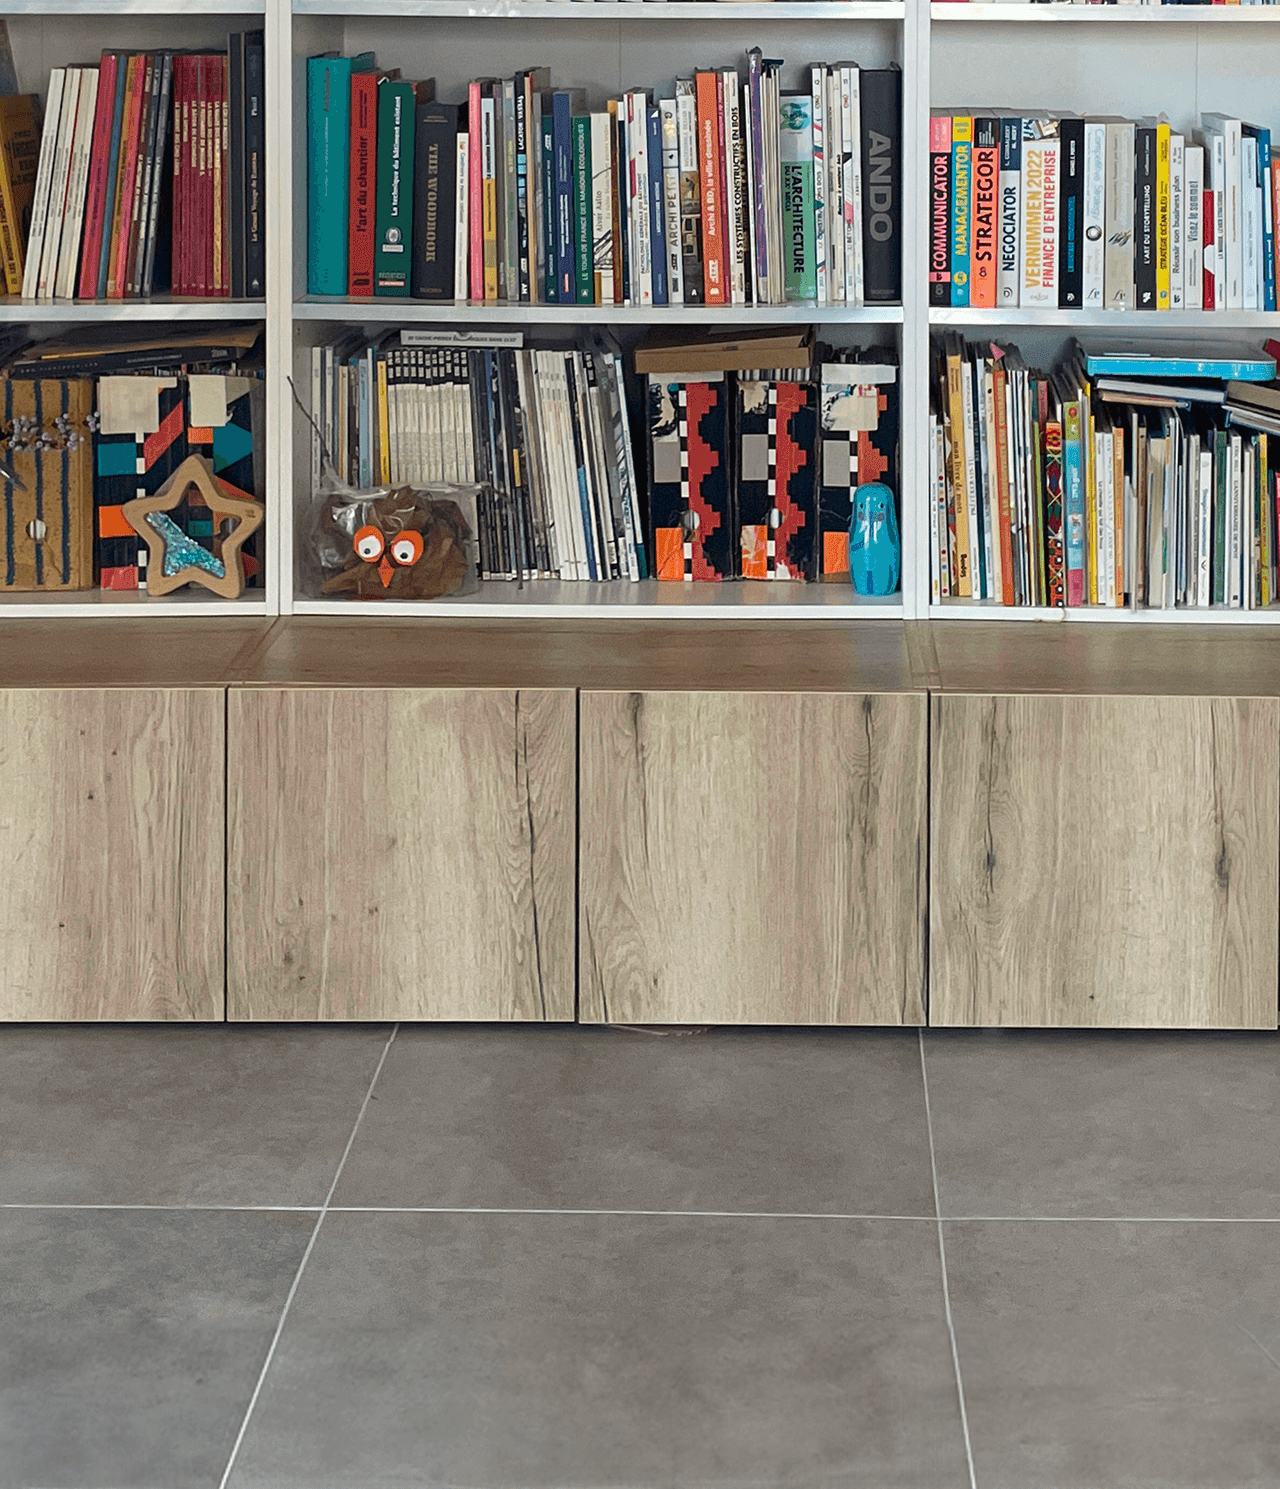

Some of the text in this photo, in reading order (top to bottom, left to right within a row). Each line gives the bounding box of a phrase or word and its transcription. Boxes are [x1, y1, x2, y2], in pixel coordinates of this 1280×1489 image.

[356, 136, 368, 232] l'art du chantier
[391, 96, 401, 216] La technique du bâtiment existant
[730, 107, 743, 264] LES SYSTÈMES CONSTRUCTIFS EN BOIS
[869, 130, 892, 241] ANDO
[1172, 175, 1182, 192] plan
[426, 144, 438, 262] THE WOODBOOK
[595, 190, 603, 210] Aalto
[704, 160, 717, 236] Archi BD, la ville
[791, 165, 805, 274] L'ARCHITECTURE
[933, 156, 948, 270] COMMUNICATOR
[955, 145, 968, 256] MANAGEMENTOR
[975, 150, 994, 262] STRATEGOR
[1002, 186, 1017, 272] NEGOCIATOR
[1025, 150, 1043, 288] VERNIMMEN 2022
[1042, 150, 1056, 288] FINANCE D'ENTREPRISE
[1143, 184, 1152, 265] L'ART DU STORYTELLING
[1158, 196, 1168, 236] OCÉAN BLEU
[1172, 194, 1181, 228] business
[1187, 181, 1199, 242] Visez le sommet
[1172, 246, 1181, 274] Réussir
[954, 460, 962, 477] livre
[954, 479, 960, 492] de
[955, 495, 963, 514] mots
[960, 553, 969, 578] Bordas
